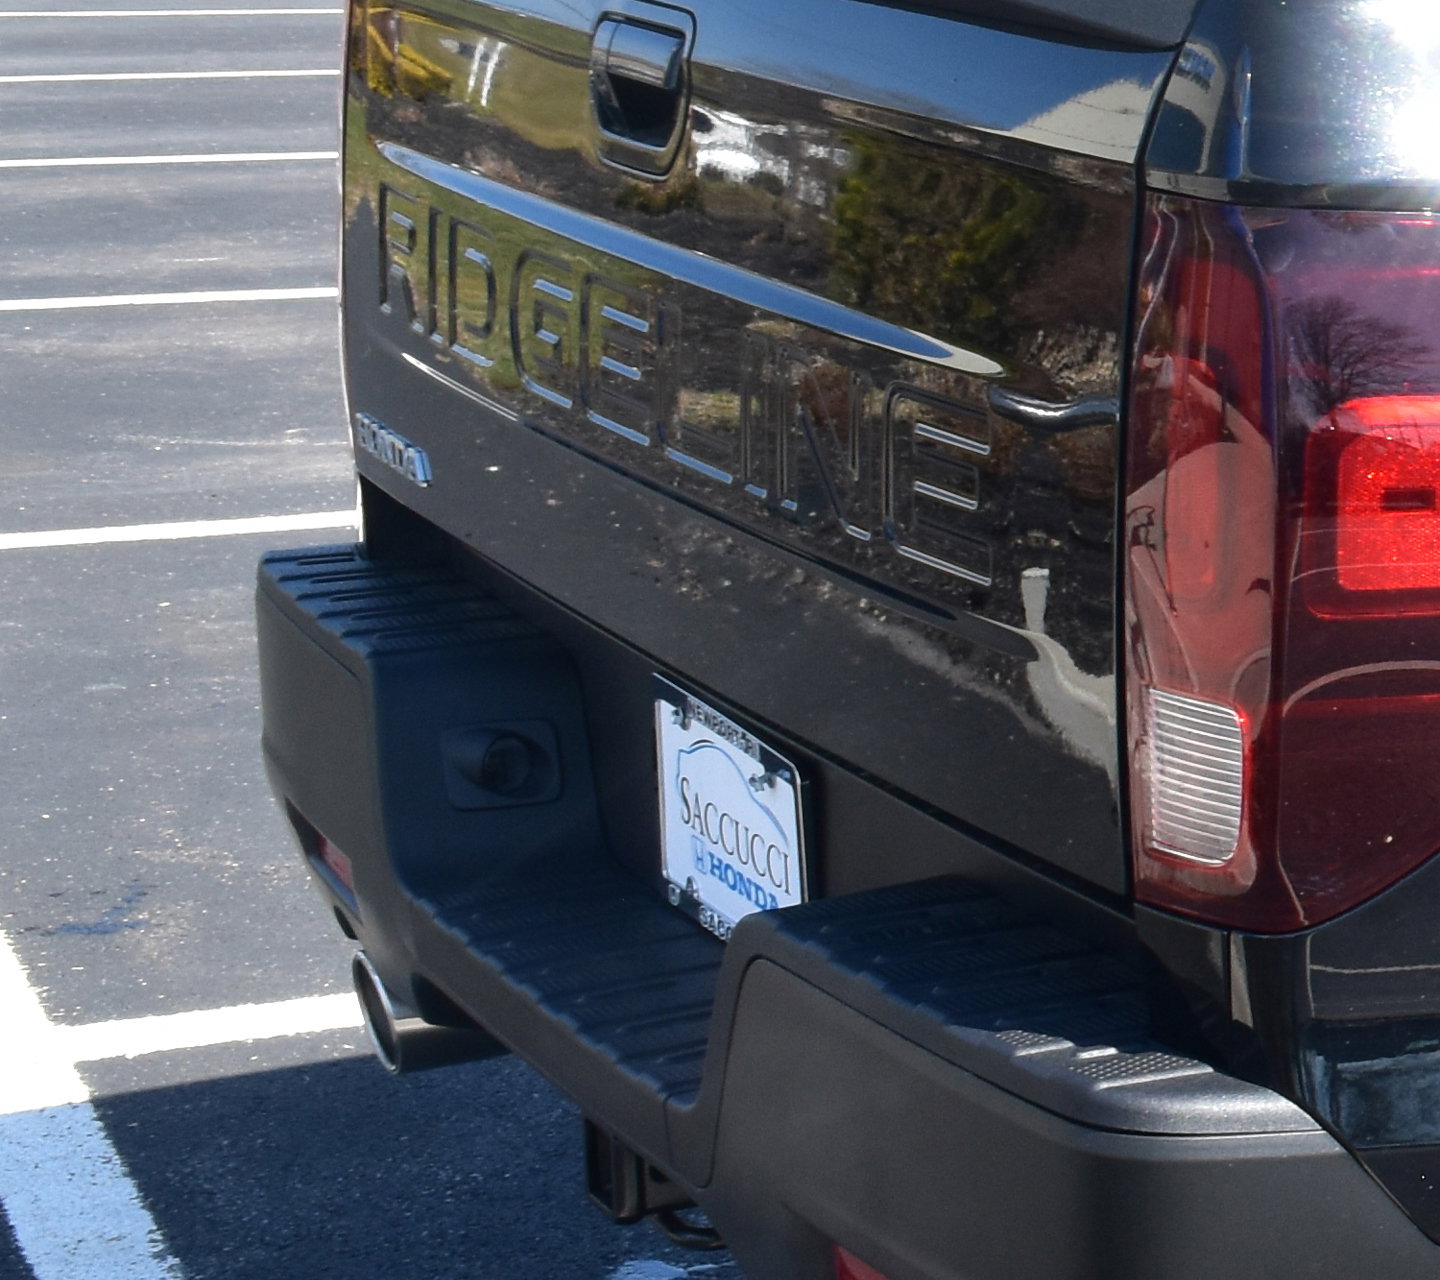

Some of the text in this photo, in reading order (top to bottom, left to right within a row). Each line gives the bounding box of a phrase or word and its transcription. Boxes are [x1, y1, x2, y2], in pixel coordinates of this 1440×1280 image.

[377, 181, 993, 588] RIDGELINE
[356, 411, 432, 488] HONDA
[680, 776, 791, 896] SACCUCCI
[707, 855, 780, 911] HONDA
